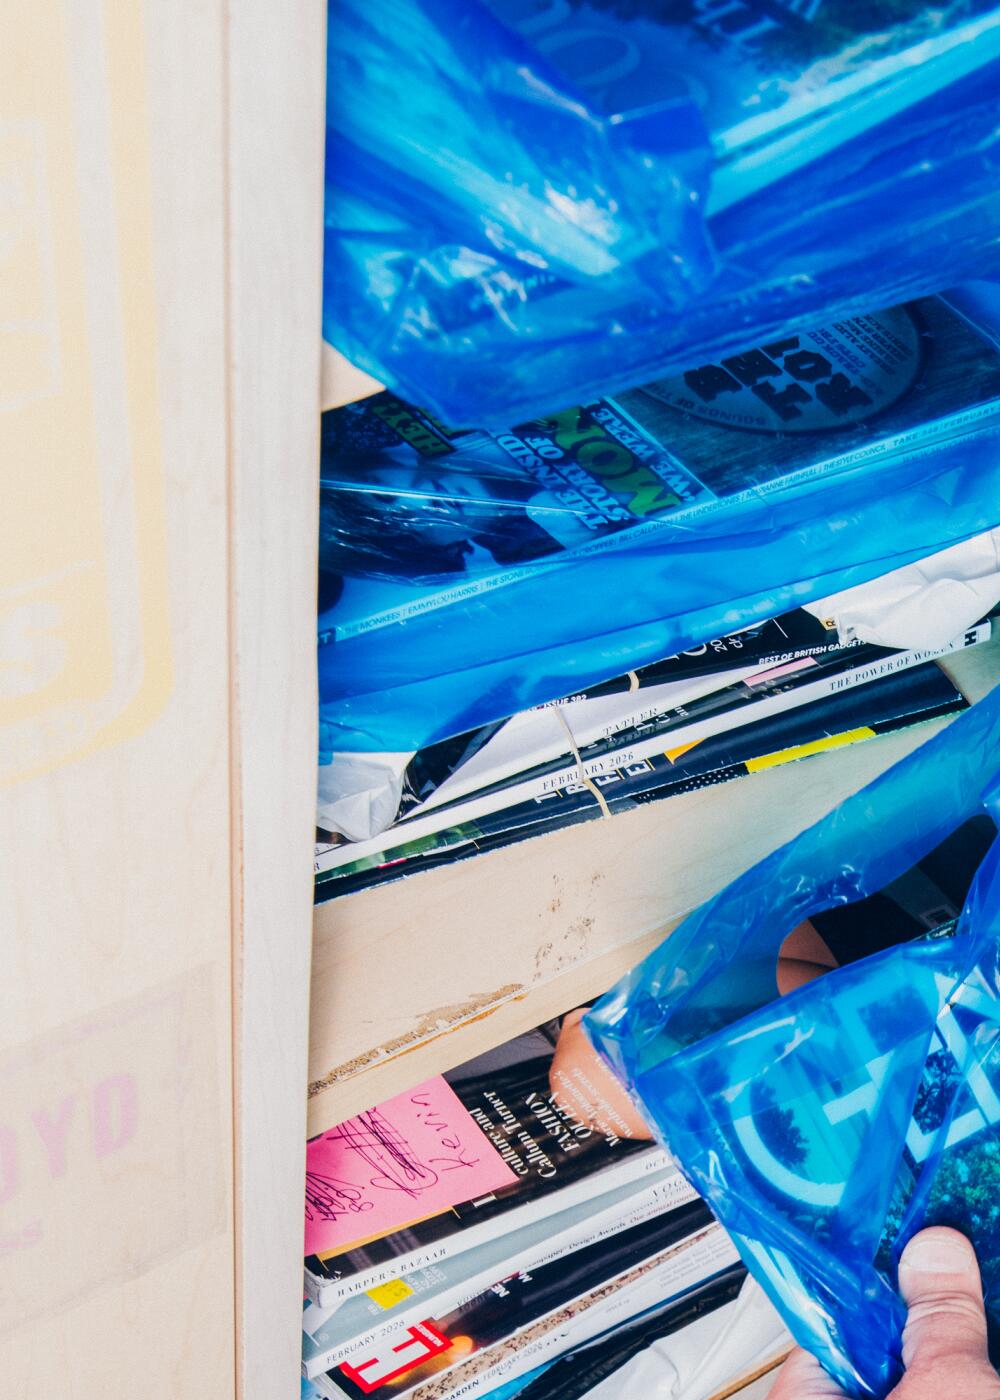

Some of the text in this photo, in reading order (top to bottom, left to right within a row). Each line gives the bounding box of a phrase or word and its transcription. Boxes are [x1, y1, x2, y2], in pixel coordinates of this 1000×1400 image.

[589, 399, 656, 467] WERE
[523, 425, 632, 531] STORY OF
[554, 480, 608, 536] THE
[758, 652, 781, 665] BEST
[794, 646, 828, 658] BRITISH
[829, 656, 912, 691] THE POWER OF
[602, 707, 658, 735] TATLER
[608, 751, 635, 767] 2026
[409, 1092, 484, 1174] Kevin
[468, 1105, 530, 1178] culture and
[482, 1087, 558, 1181] Callum Turner
[521, 1090, 580, 1155] FASHION
[398, 1246, 448, 1271] BAZAAR
[325, 1333, 377, 1364] FEBRUARY
